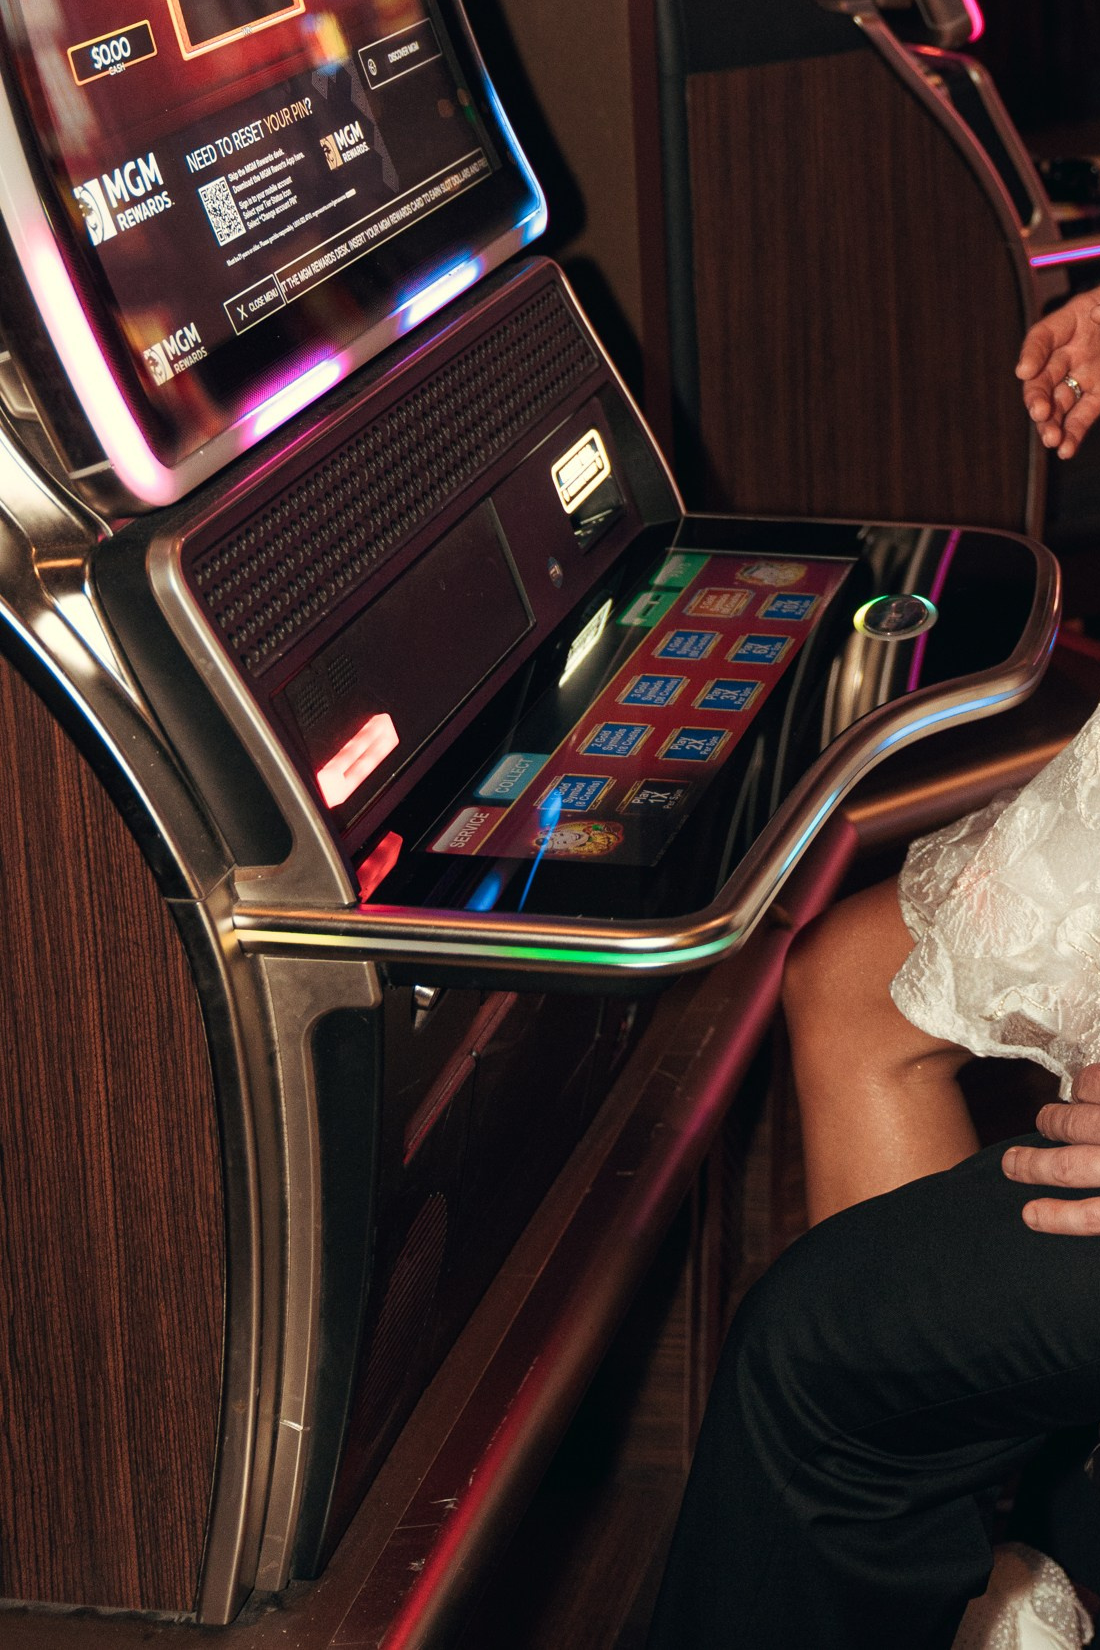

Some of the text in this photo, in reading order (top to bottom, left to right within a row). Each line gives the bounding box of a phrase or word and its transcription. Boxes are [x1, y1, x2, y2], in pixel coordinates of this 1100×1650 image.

[91, 36, 131, 70] $0.00
[108, 63, 126, 76] CASH
[186, 97, 313, 173] NEED TO RESET YOUR PIN?
[334, 121, 364, 151] MGM
[101, 152, 164, 209] MGM
[287, 274, 301, 289] THE
[311, 251, 337, 274] REWARDS
[348, 232, 367, 251] INSERT
[365, 224, 381, 240] YOUR
[388, 204, 412, 226] REWARDS
[248, 299, 265, 312] CLOSE
[263, 288, 279, 304] MENU
[162, 322, 202, 361] MGM
[173, 346, 208, 374] REWARDS
[738, 642, 753, 654] Play
[635, 682, 651, 694] Gold
[642, 680, 665, 702] Symbols
[705, 688, 721, 701] Play
[720, 688, 741, 700] 3X
[591, 730, 612, 748] 2 Gold
[602, 728, 627, 751] Symbols
[670, 736, 690, 751] Play
[685, 737, 707, 751] 2X
[699, 736, 720, 755] Per Spin
[495, 758, 534, 794] COLLECT
[562, 782, 586, 804] Symbol
[579, 780, 604, 801] Credits)
[631, 789, 653, 804] Play
[648, 792, 671, 803] 1X
[663, 799, 675, 810] Per
[450, 811, 489, 848] SERVICE
